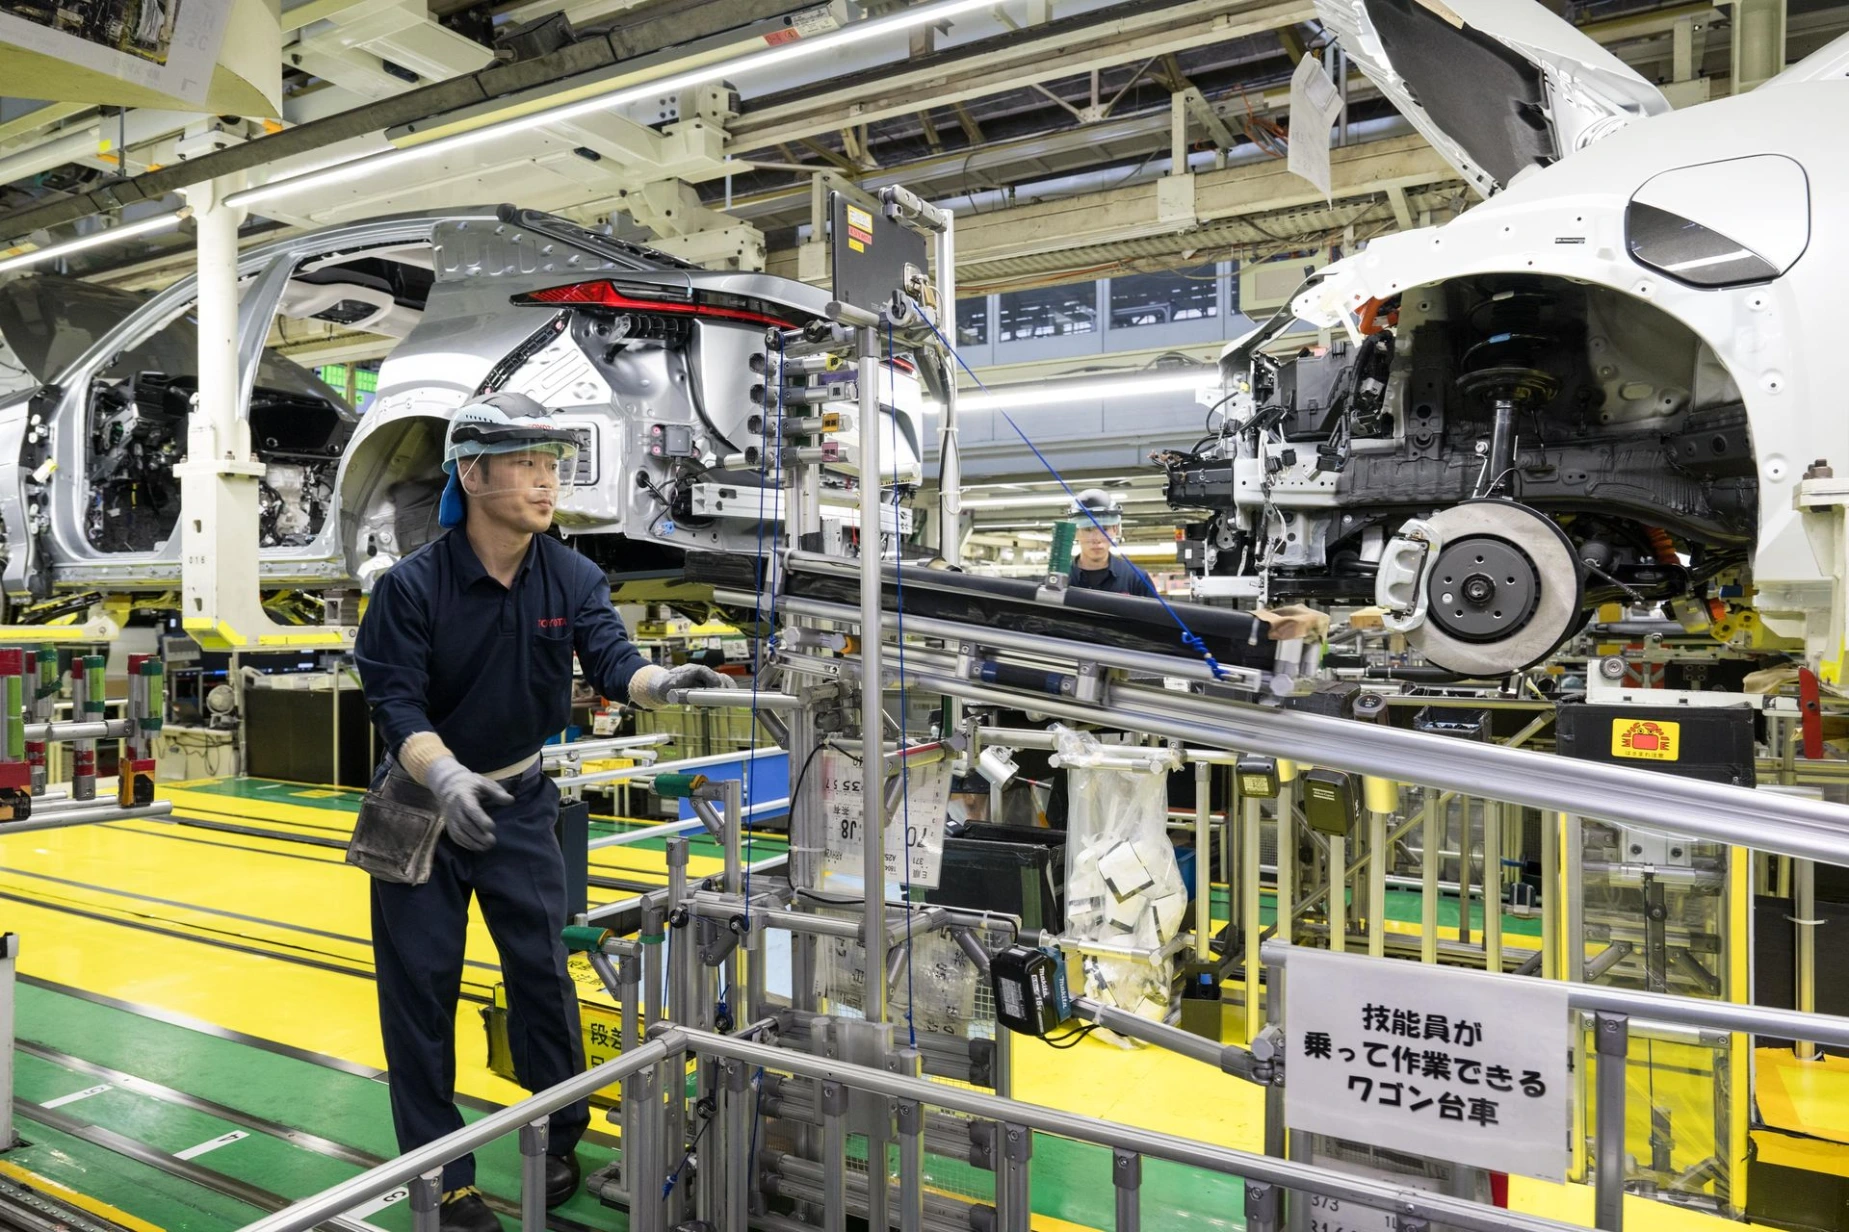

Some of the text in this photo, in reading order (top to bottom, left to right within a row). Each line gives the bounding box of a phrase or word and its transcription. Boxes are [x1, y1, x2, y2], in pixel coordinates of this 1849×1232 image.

[537, 617, 567, 628] TOYOTA
[841, 819, 857, 839] J8
[913, 857, 924, 865] 371
[1362, 1003, 1482, 1047] 技能員が
[1304, 1031, 1546, 1098] 乗って作業できる
[1348, 1075, 1499, 1127] ワゴン台車
